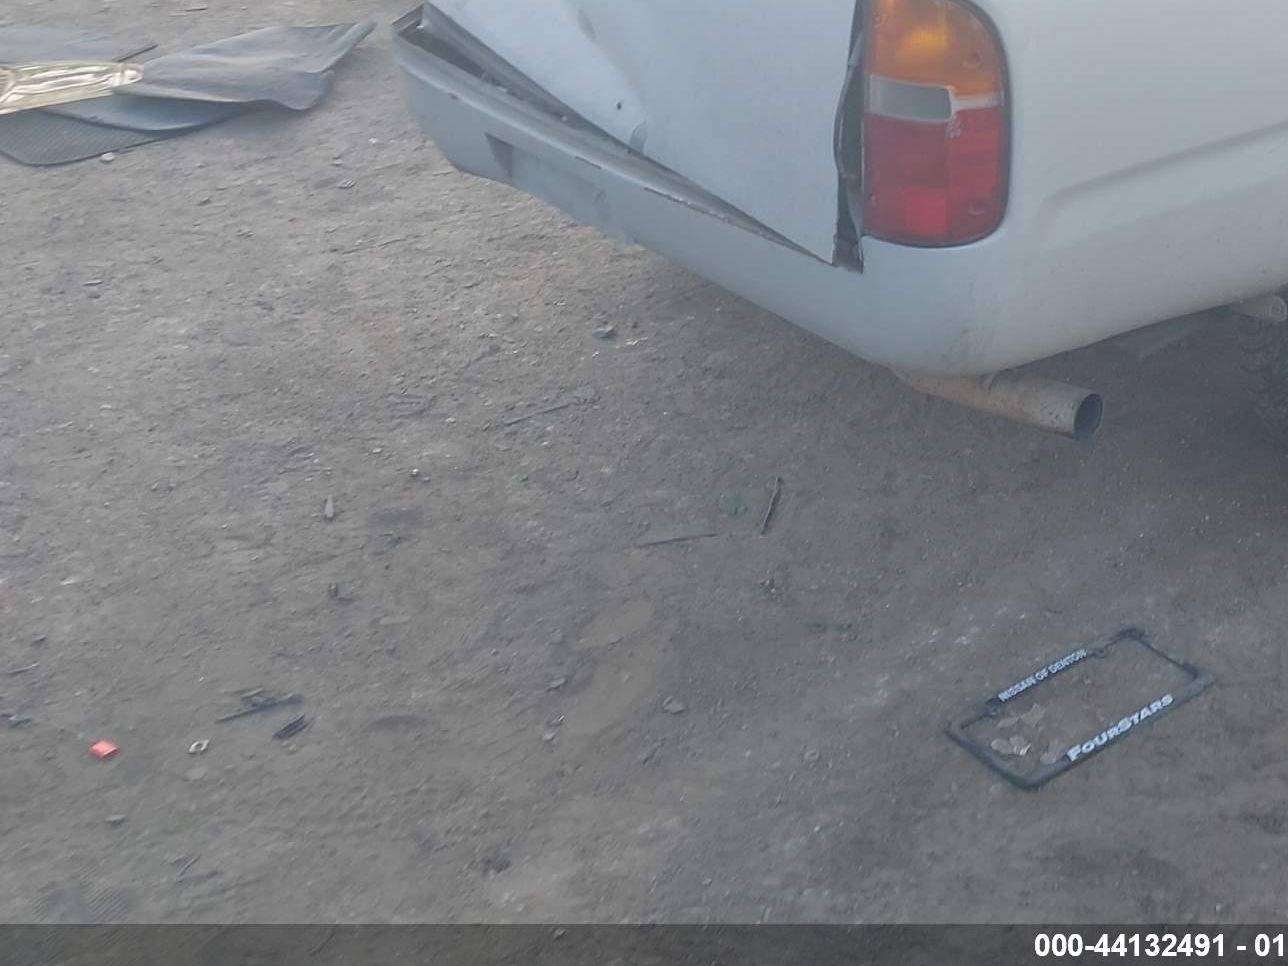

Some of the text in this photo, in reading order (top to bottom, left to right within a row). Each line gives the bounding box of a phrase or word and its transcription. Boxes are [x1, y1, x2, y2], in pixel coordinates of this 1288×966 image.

[998, 649, 1087, 702] NISSAN OF DENTON
[1066, 693, 1174, 762] FOURSTARS
